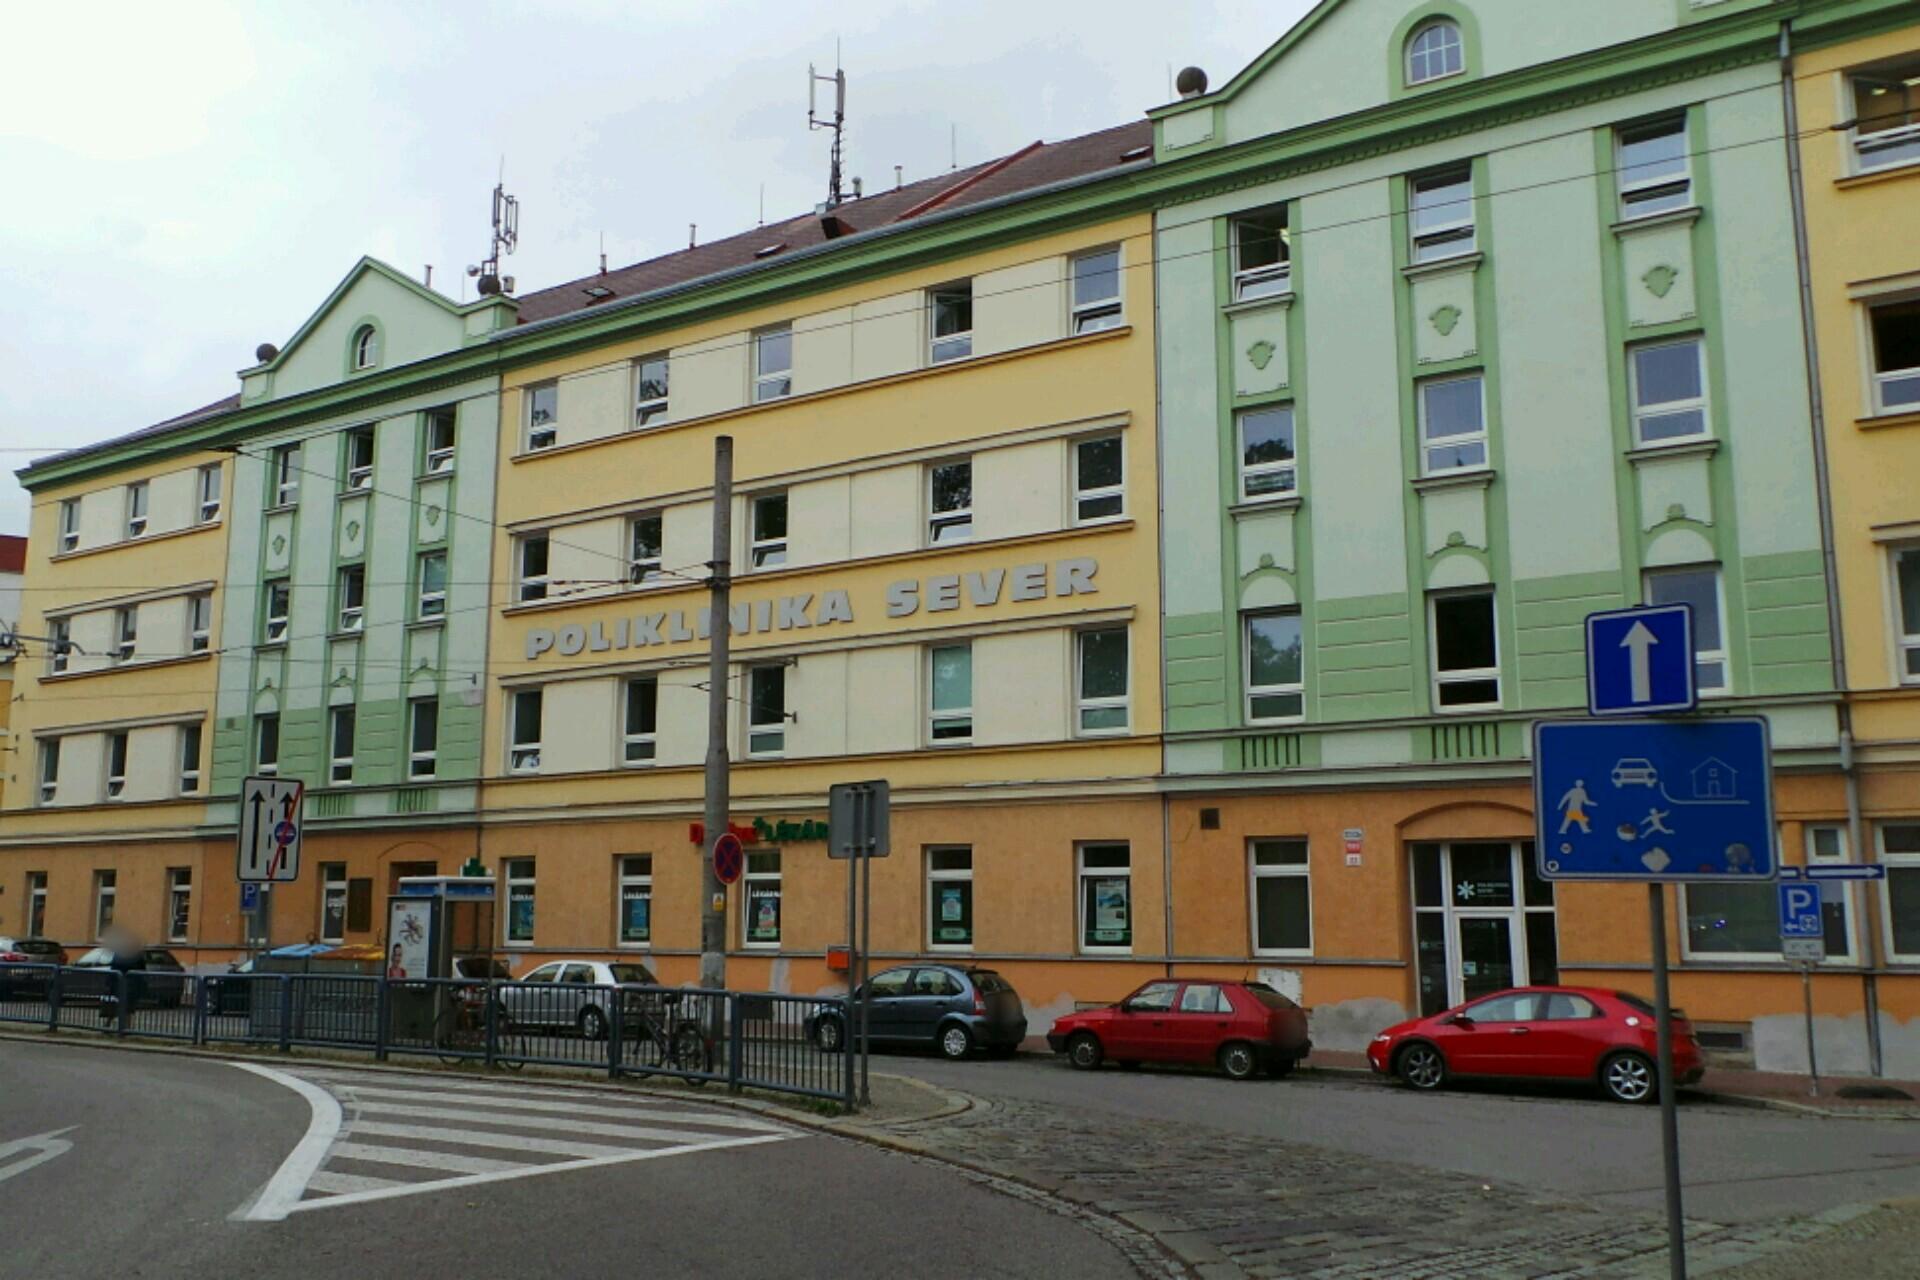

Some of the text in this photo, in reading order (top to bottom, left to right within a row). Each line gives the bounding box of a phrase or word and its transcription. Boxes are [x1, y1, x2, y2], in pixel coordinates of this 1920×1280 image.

[526, 556, 1099, 660] POLIKLINIKA SEVER
[244, 884, 256, 900] P
[1787, 888, 1813, 919] P
